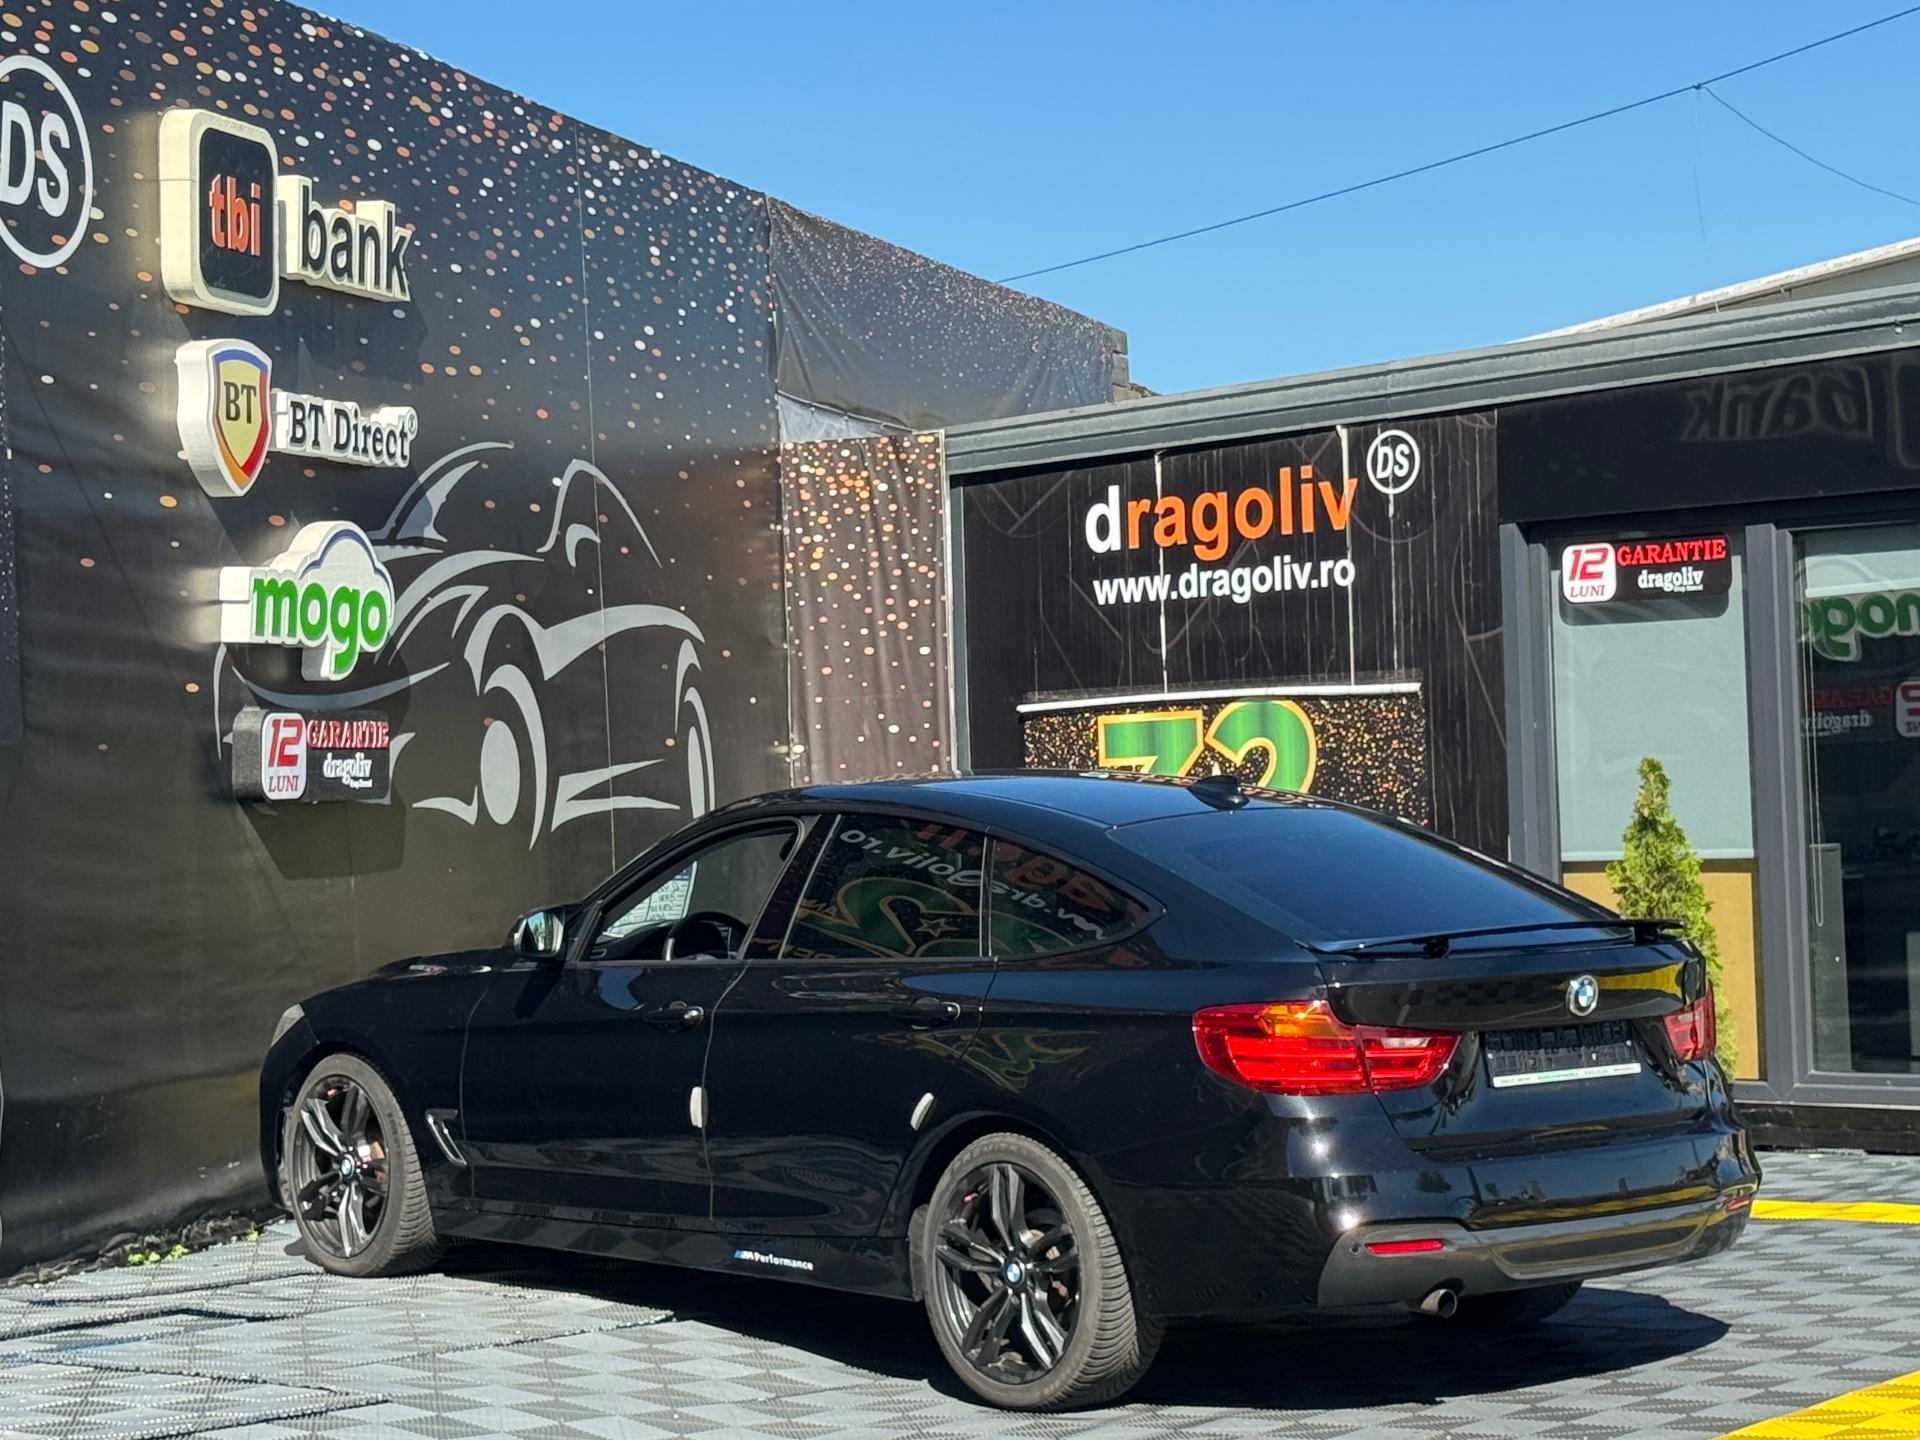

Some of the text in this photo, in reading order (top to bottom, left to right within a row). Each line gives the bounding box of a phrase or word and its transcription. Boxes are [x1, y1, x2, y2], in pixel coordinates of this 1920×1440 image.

[1, 102, 71, 218] DS
[208, 174, 413, 300] tbi bank
[223, 381, 257, 424] BT
[290, 401, 325, 447] BT
[1376, 450, 1410, 480] DS
[1085, 465, 1358, 561] dragoliv
[1569, 546, 1609, 582] 12
[1617, 539, 1727, 566] GARANTIE
[1093, 555, 1355, 605] www.dragoliv.ro
[1570, 585, 1605, 598] LUNI
[1638, 565, 1704, 592] dragoliv
[253, 576, 388, 674] mogo
[268, 718, 303, 768] 12
[307, 719, 390, 749] GARANTIE
[267, 775, 300, 793] LUNI
[323, 752, 372, 785] dragoliv
[754, 1251, 814, 1271] Performance
